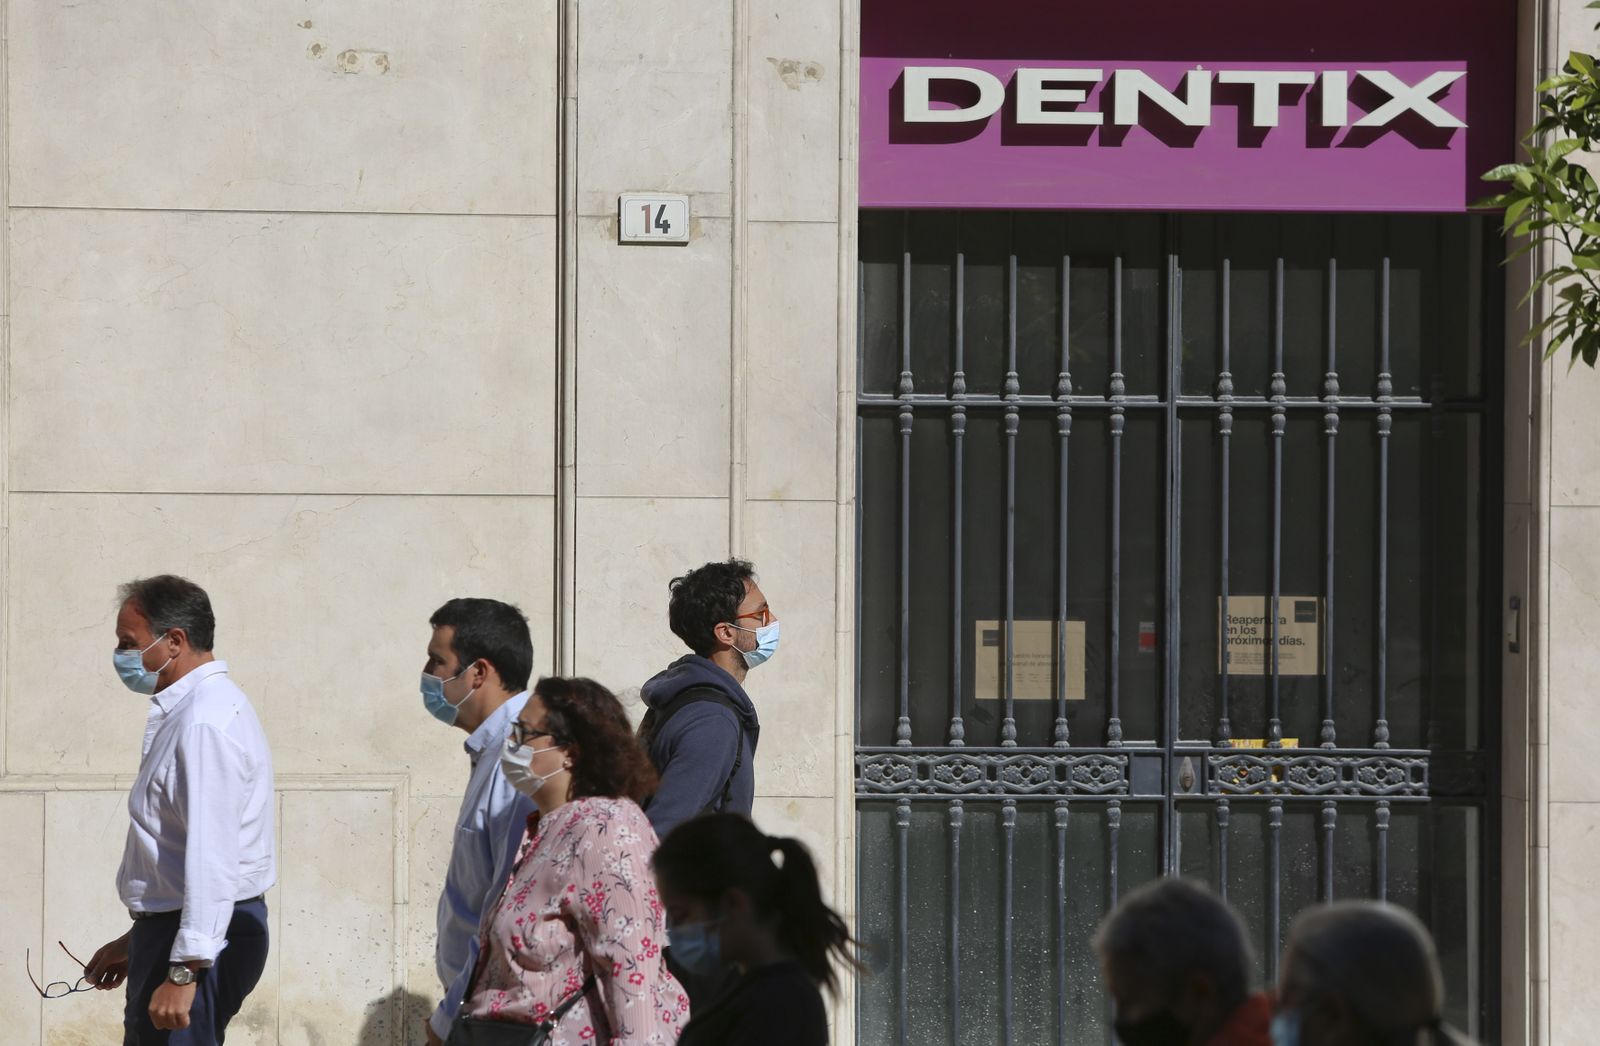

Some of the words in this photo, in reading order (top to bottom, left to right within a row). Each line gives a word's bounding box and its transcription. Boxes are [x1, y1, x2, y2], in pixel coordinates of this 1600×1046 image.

[903, 66, 1469, 128] DENTIX
[641, 204, 671, 234] 14
[1240, 625, 1257, 635] los
[1278, 635, 1306, 646] días.
